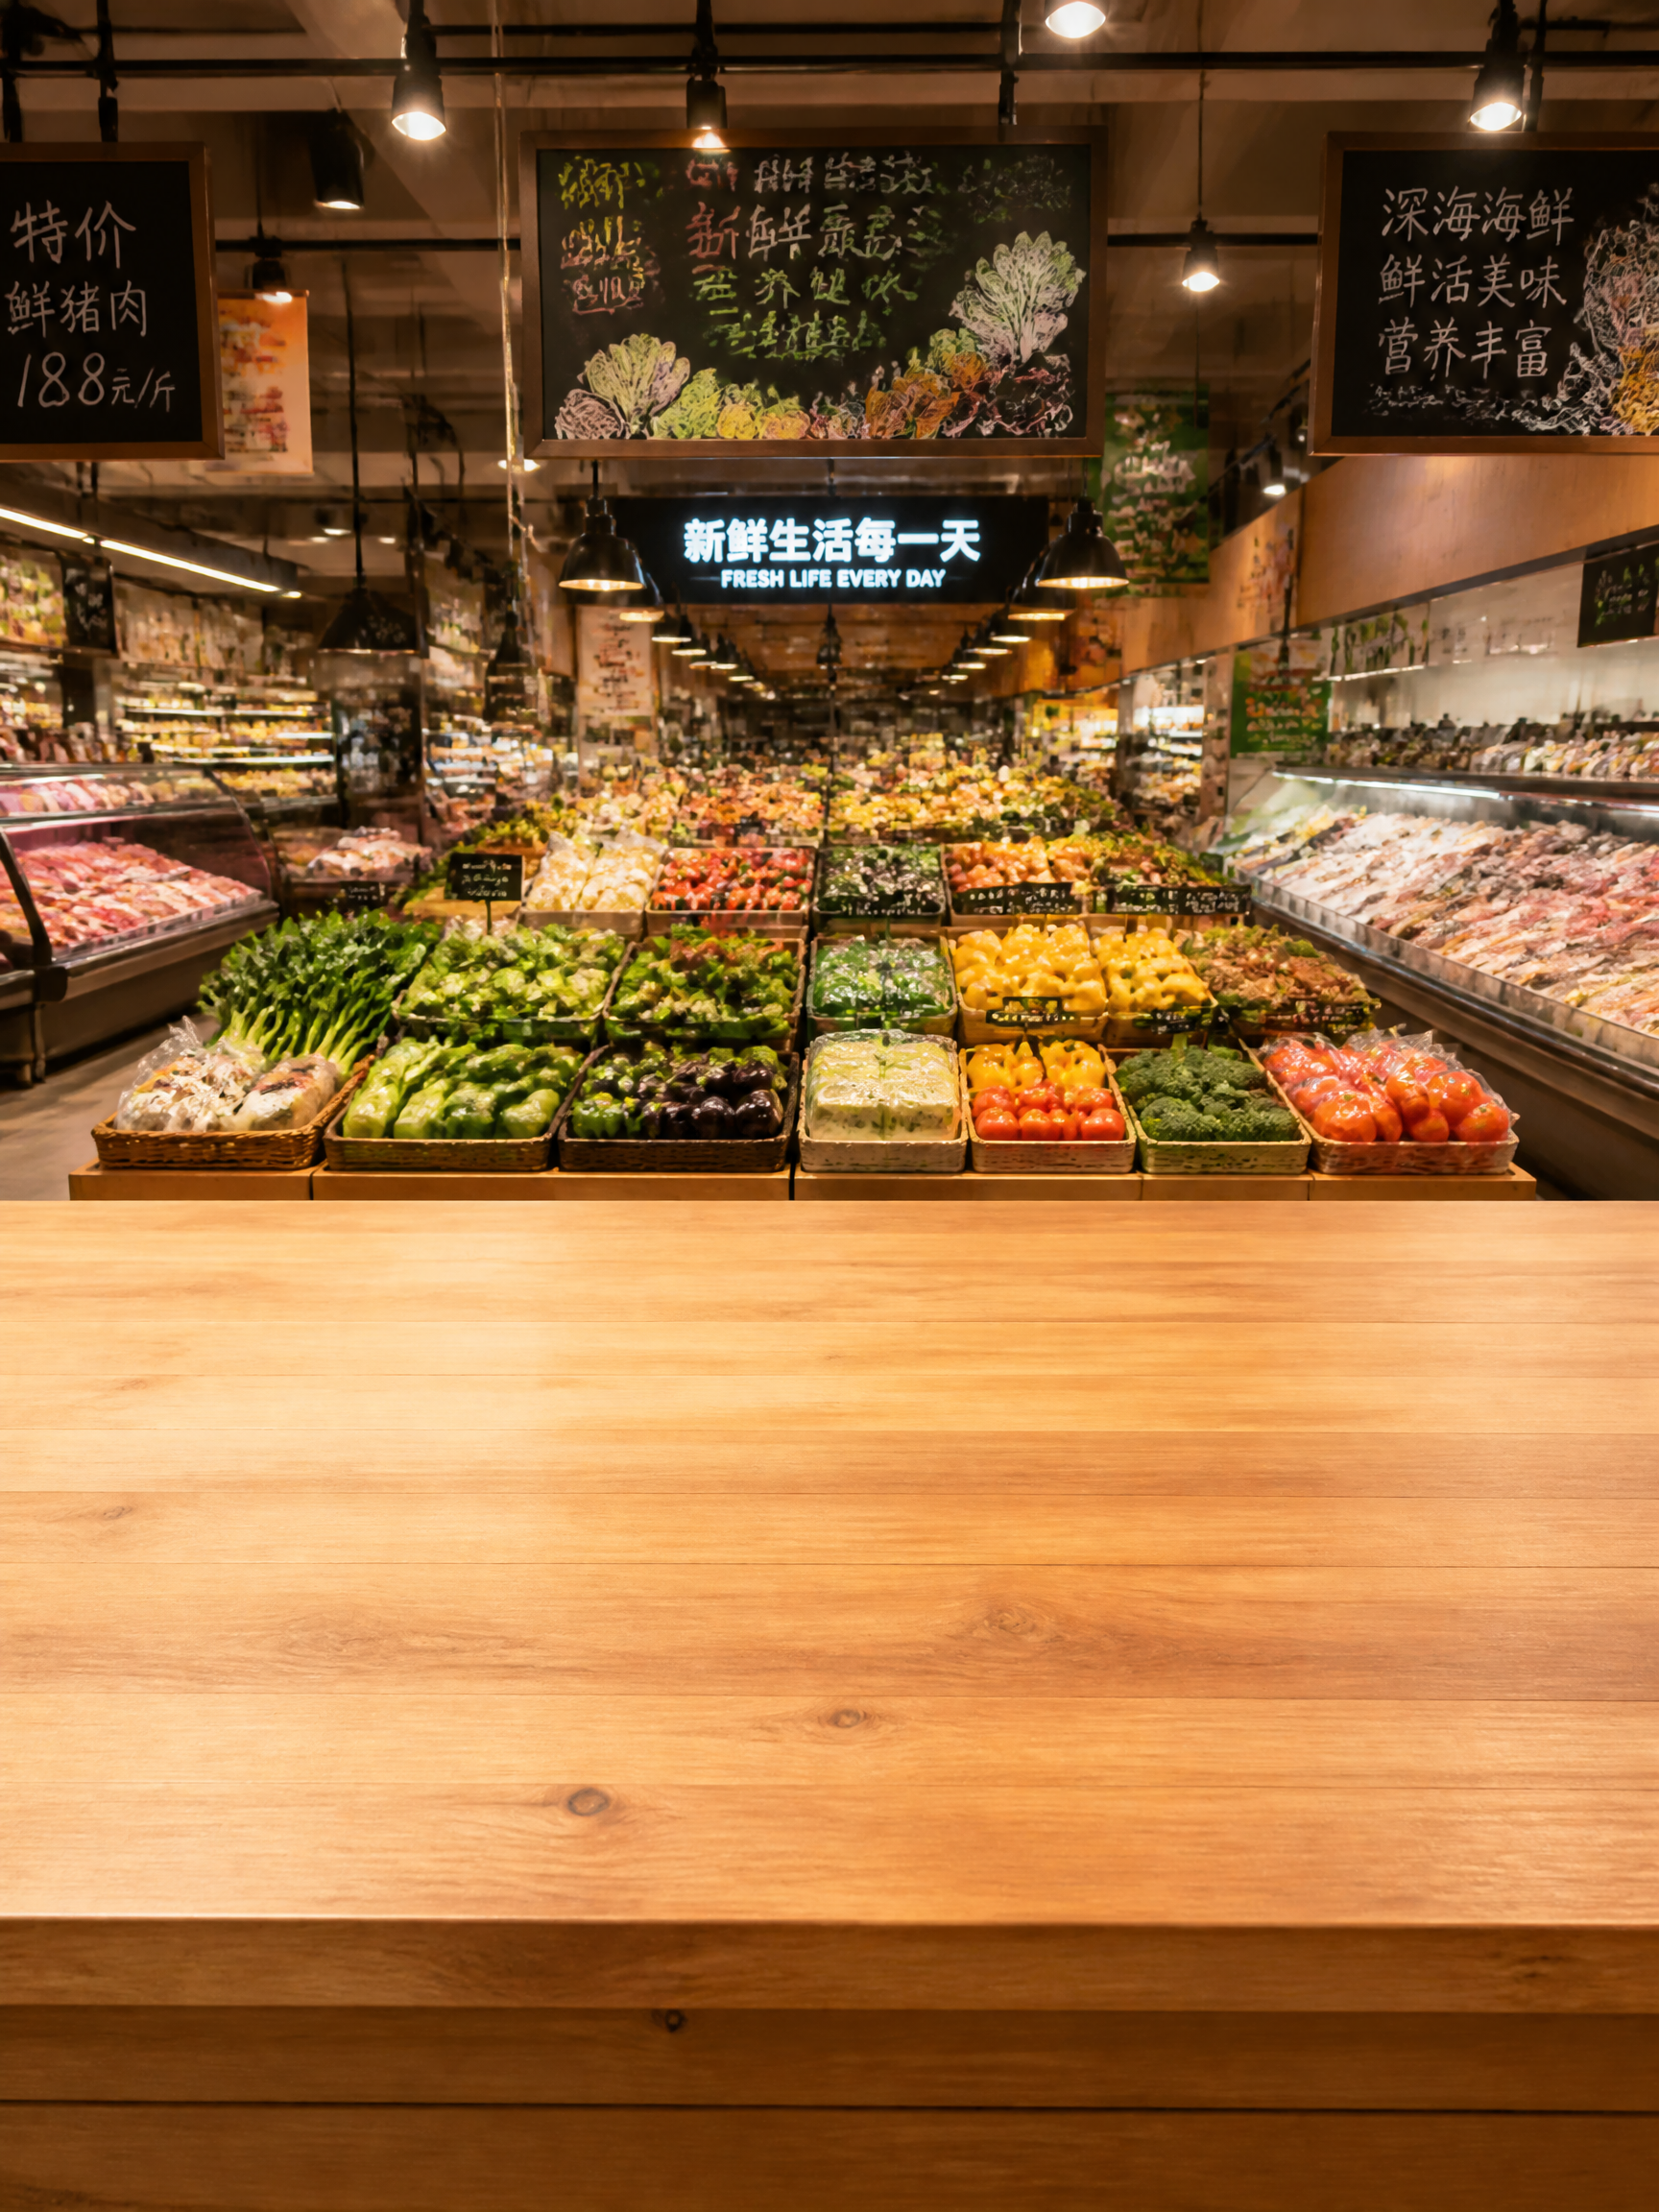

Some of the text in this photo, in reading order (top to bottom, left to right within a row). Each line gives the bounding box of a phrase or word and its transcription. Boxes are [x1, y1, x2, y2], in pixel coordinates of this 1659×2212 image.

[10, 199, 137, 269] 特价
[1381, 184, 1575, 247] 深海海鲜
[4, 279, 147, 338] 鲜猪肉
[1377, 252, 1568, 309] 鲜活美味
[1378, 316, 1552, 382] 营养丰富
[683, 517, 982, 564] 新鲜生活每一天
[721, 568, 947, 589] FRESH LIFE EVERY DAY
